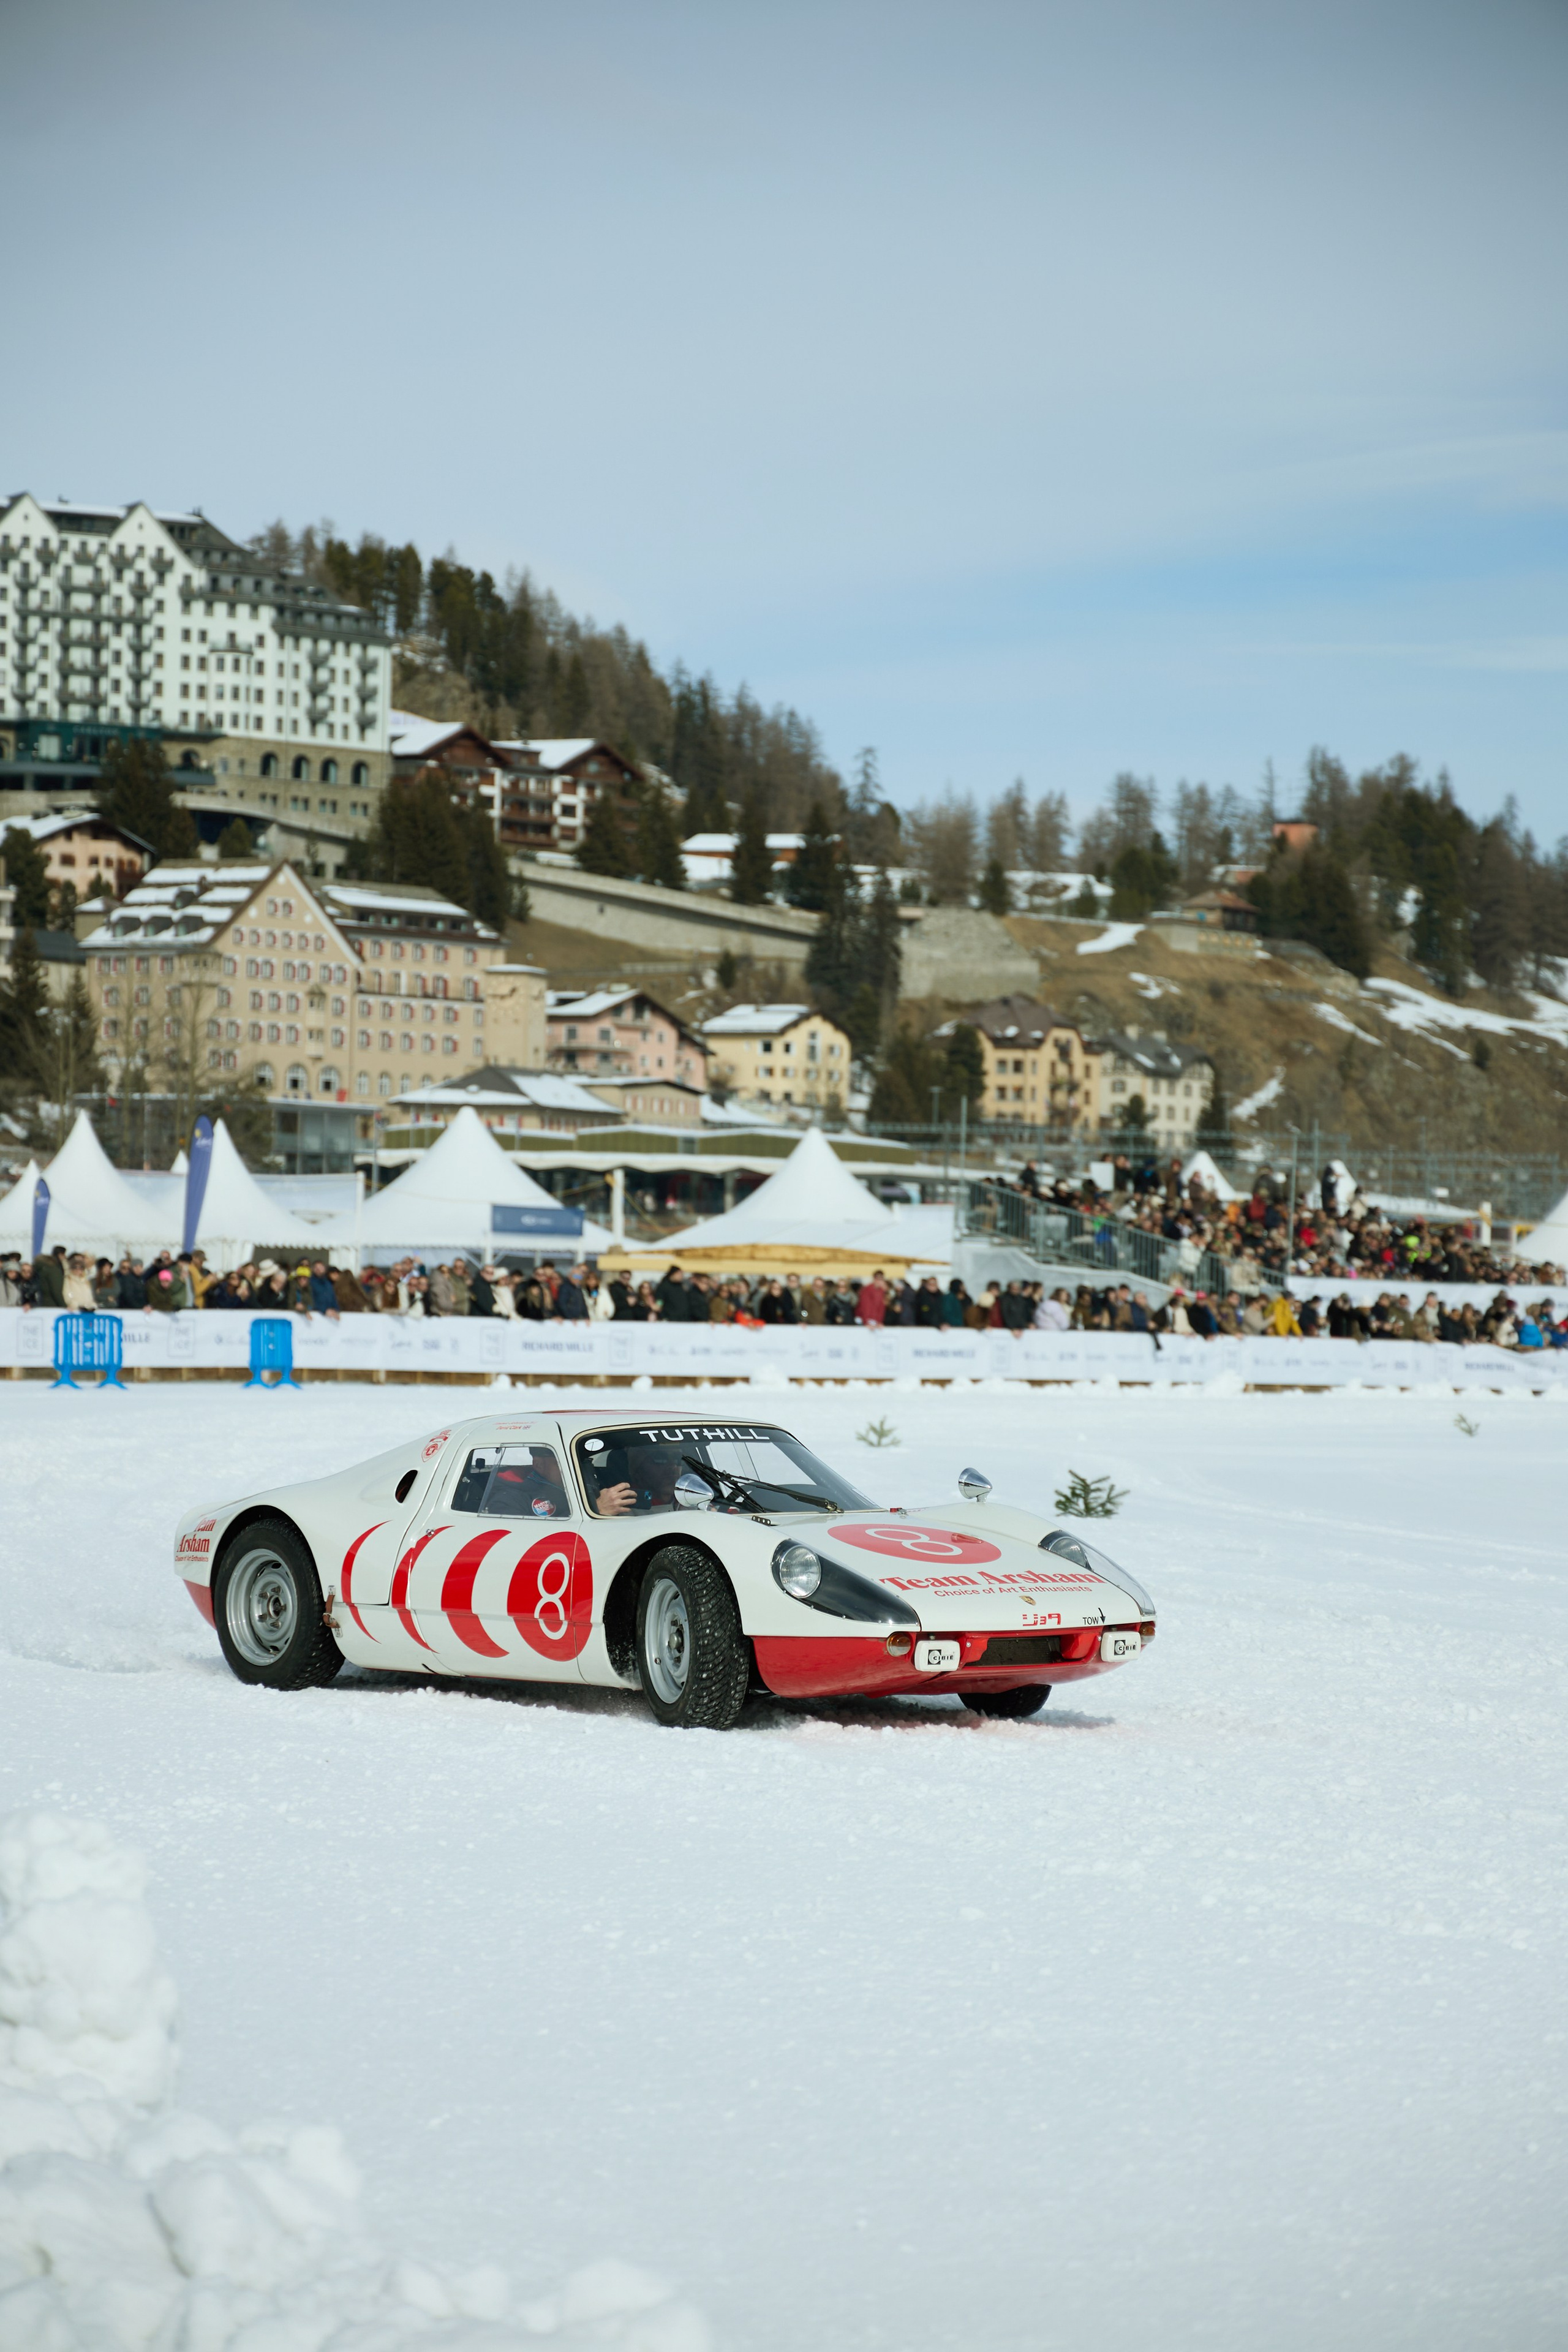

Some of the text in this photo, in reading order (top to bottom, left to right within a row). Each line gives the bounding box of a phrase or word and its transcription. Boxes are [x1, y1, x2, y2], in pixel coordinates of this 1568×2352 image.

[639, 1428, 770, 1442] TUTHILL
[176, 1534, 210, 1553] Arsham
[864, 1528, 963, 1556] 8
[878, 1570, 1108, 1591] Team Arsham
[533, 1552, 570, 1640] 8
[933, 1589, 981, 1597] Choice
